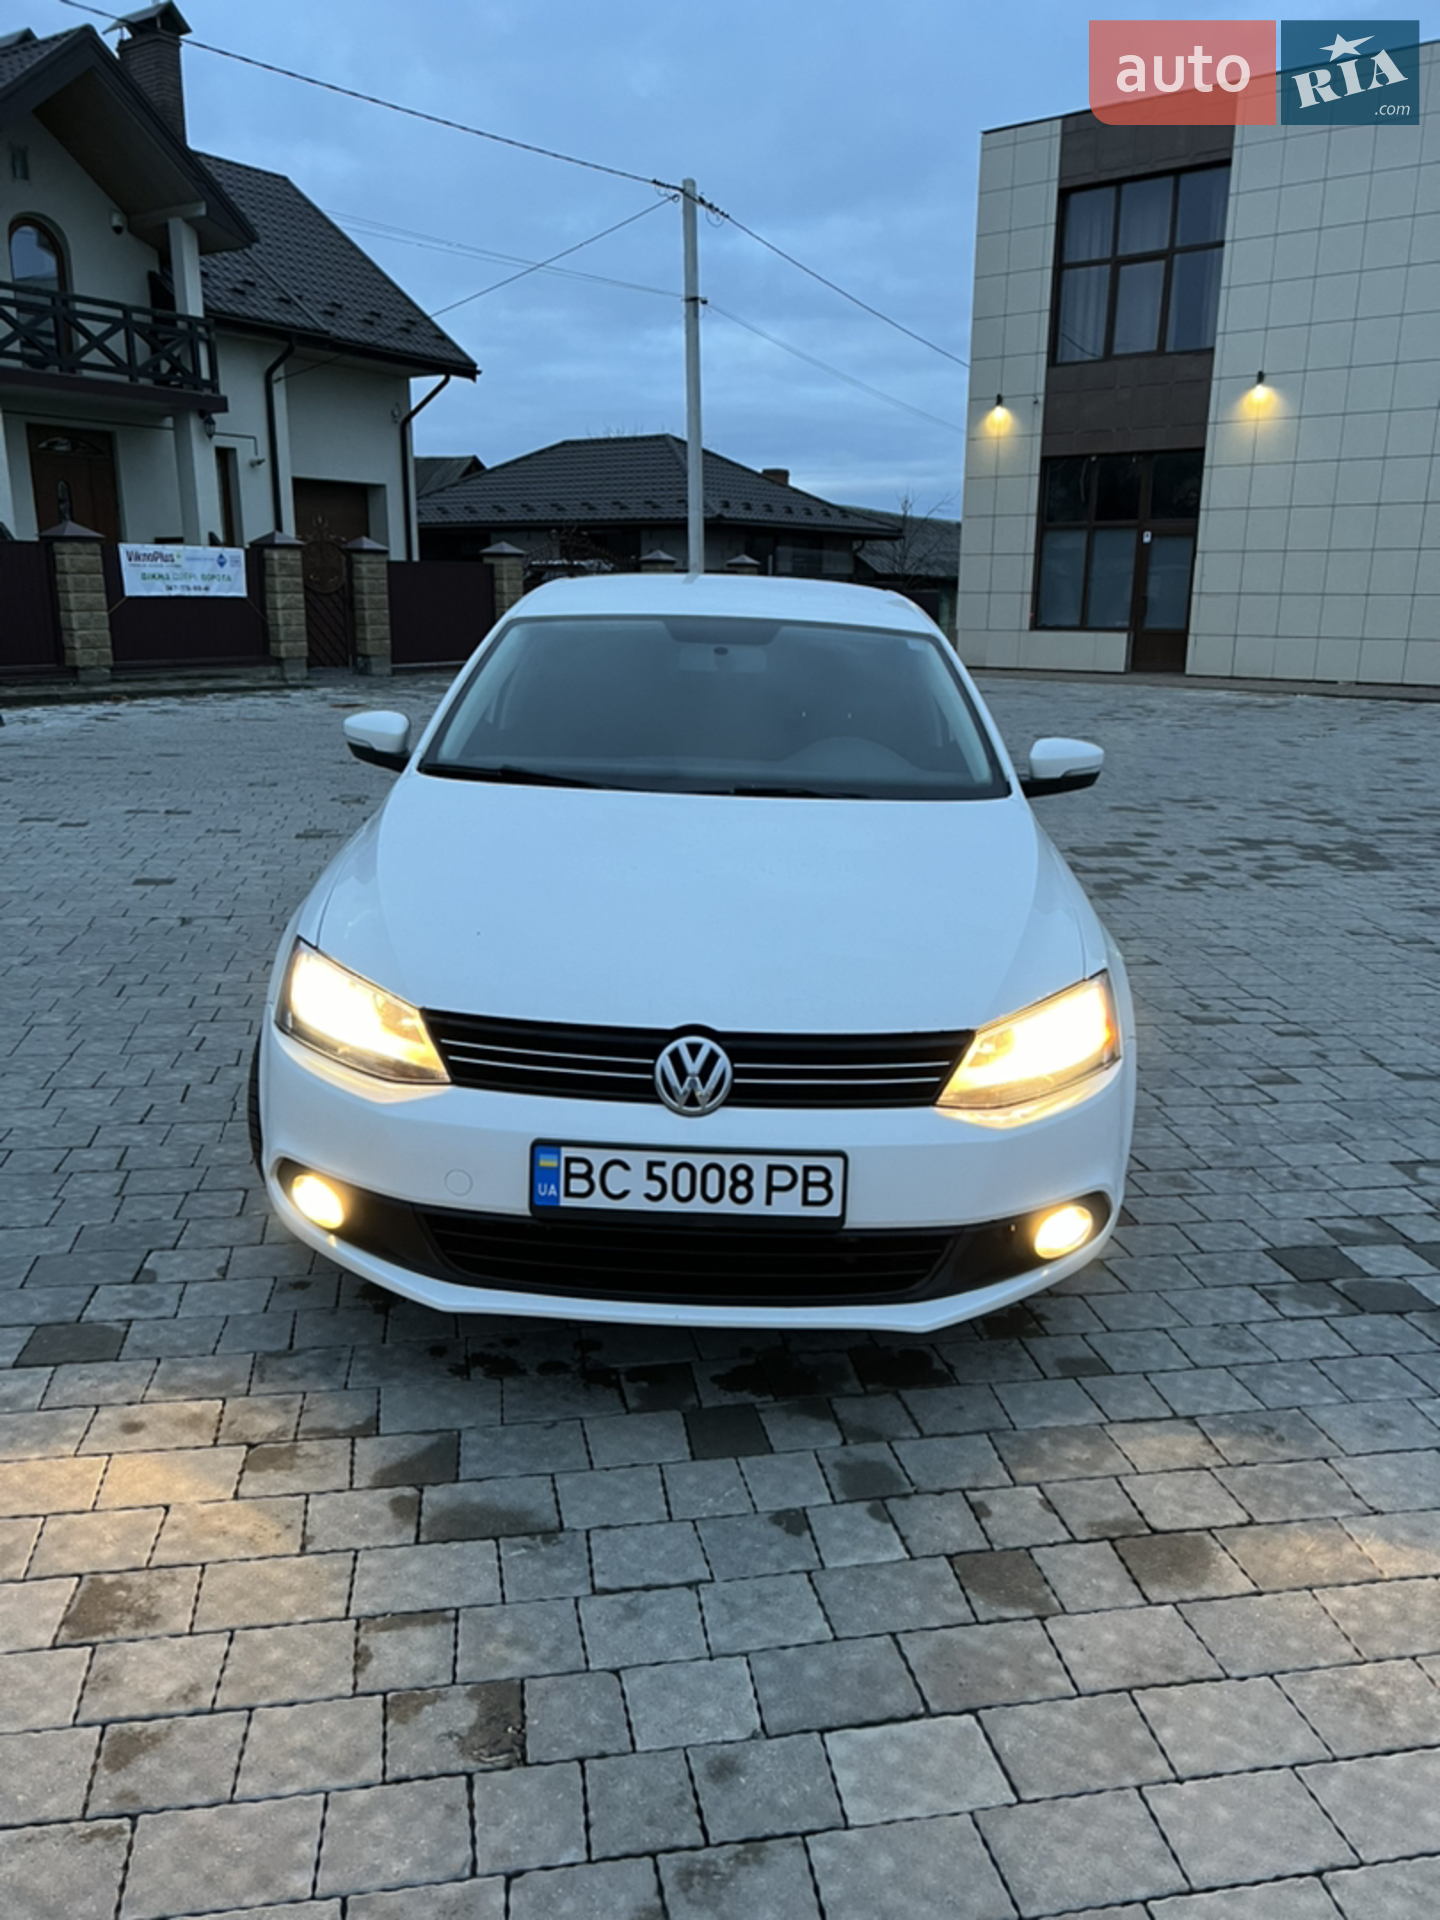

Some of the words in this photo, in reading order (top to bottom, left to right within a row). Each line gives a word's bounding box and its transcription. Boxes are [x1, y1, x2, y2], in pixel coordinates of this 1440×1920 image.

[654, 1036, 732, 1117] VW
[537, 1182, 557, 1197] UA
[563, 1155, 631, 1201] BC
[643, 1160, 755, 1205] 5008
[764, 1164, 834, 1207] PB
